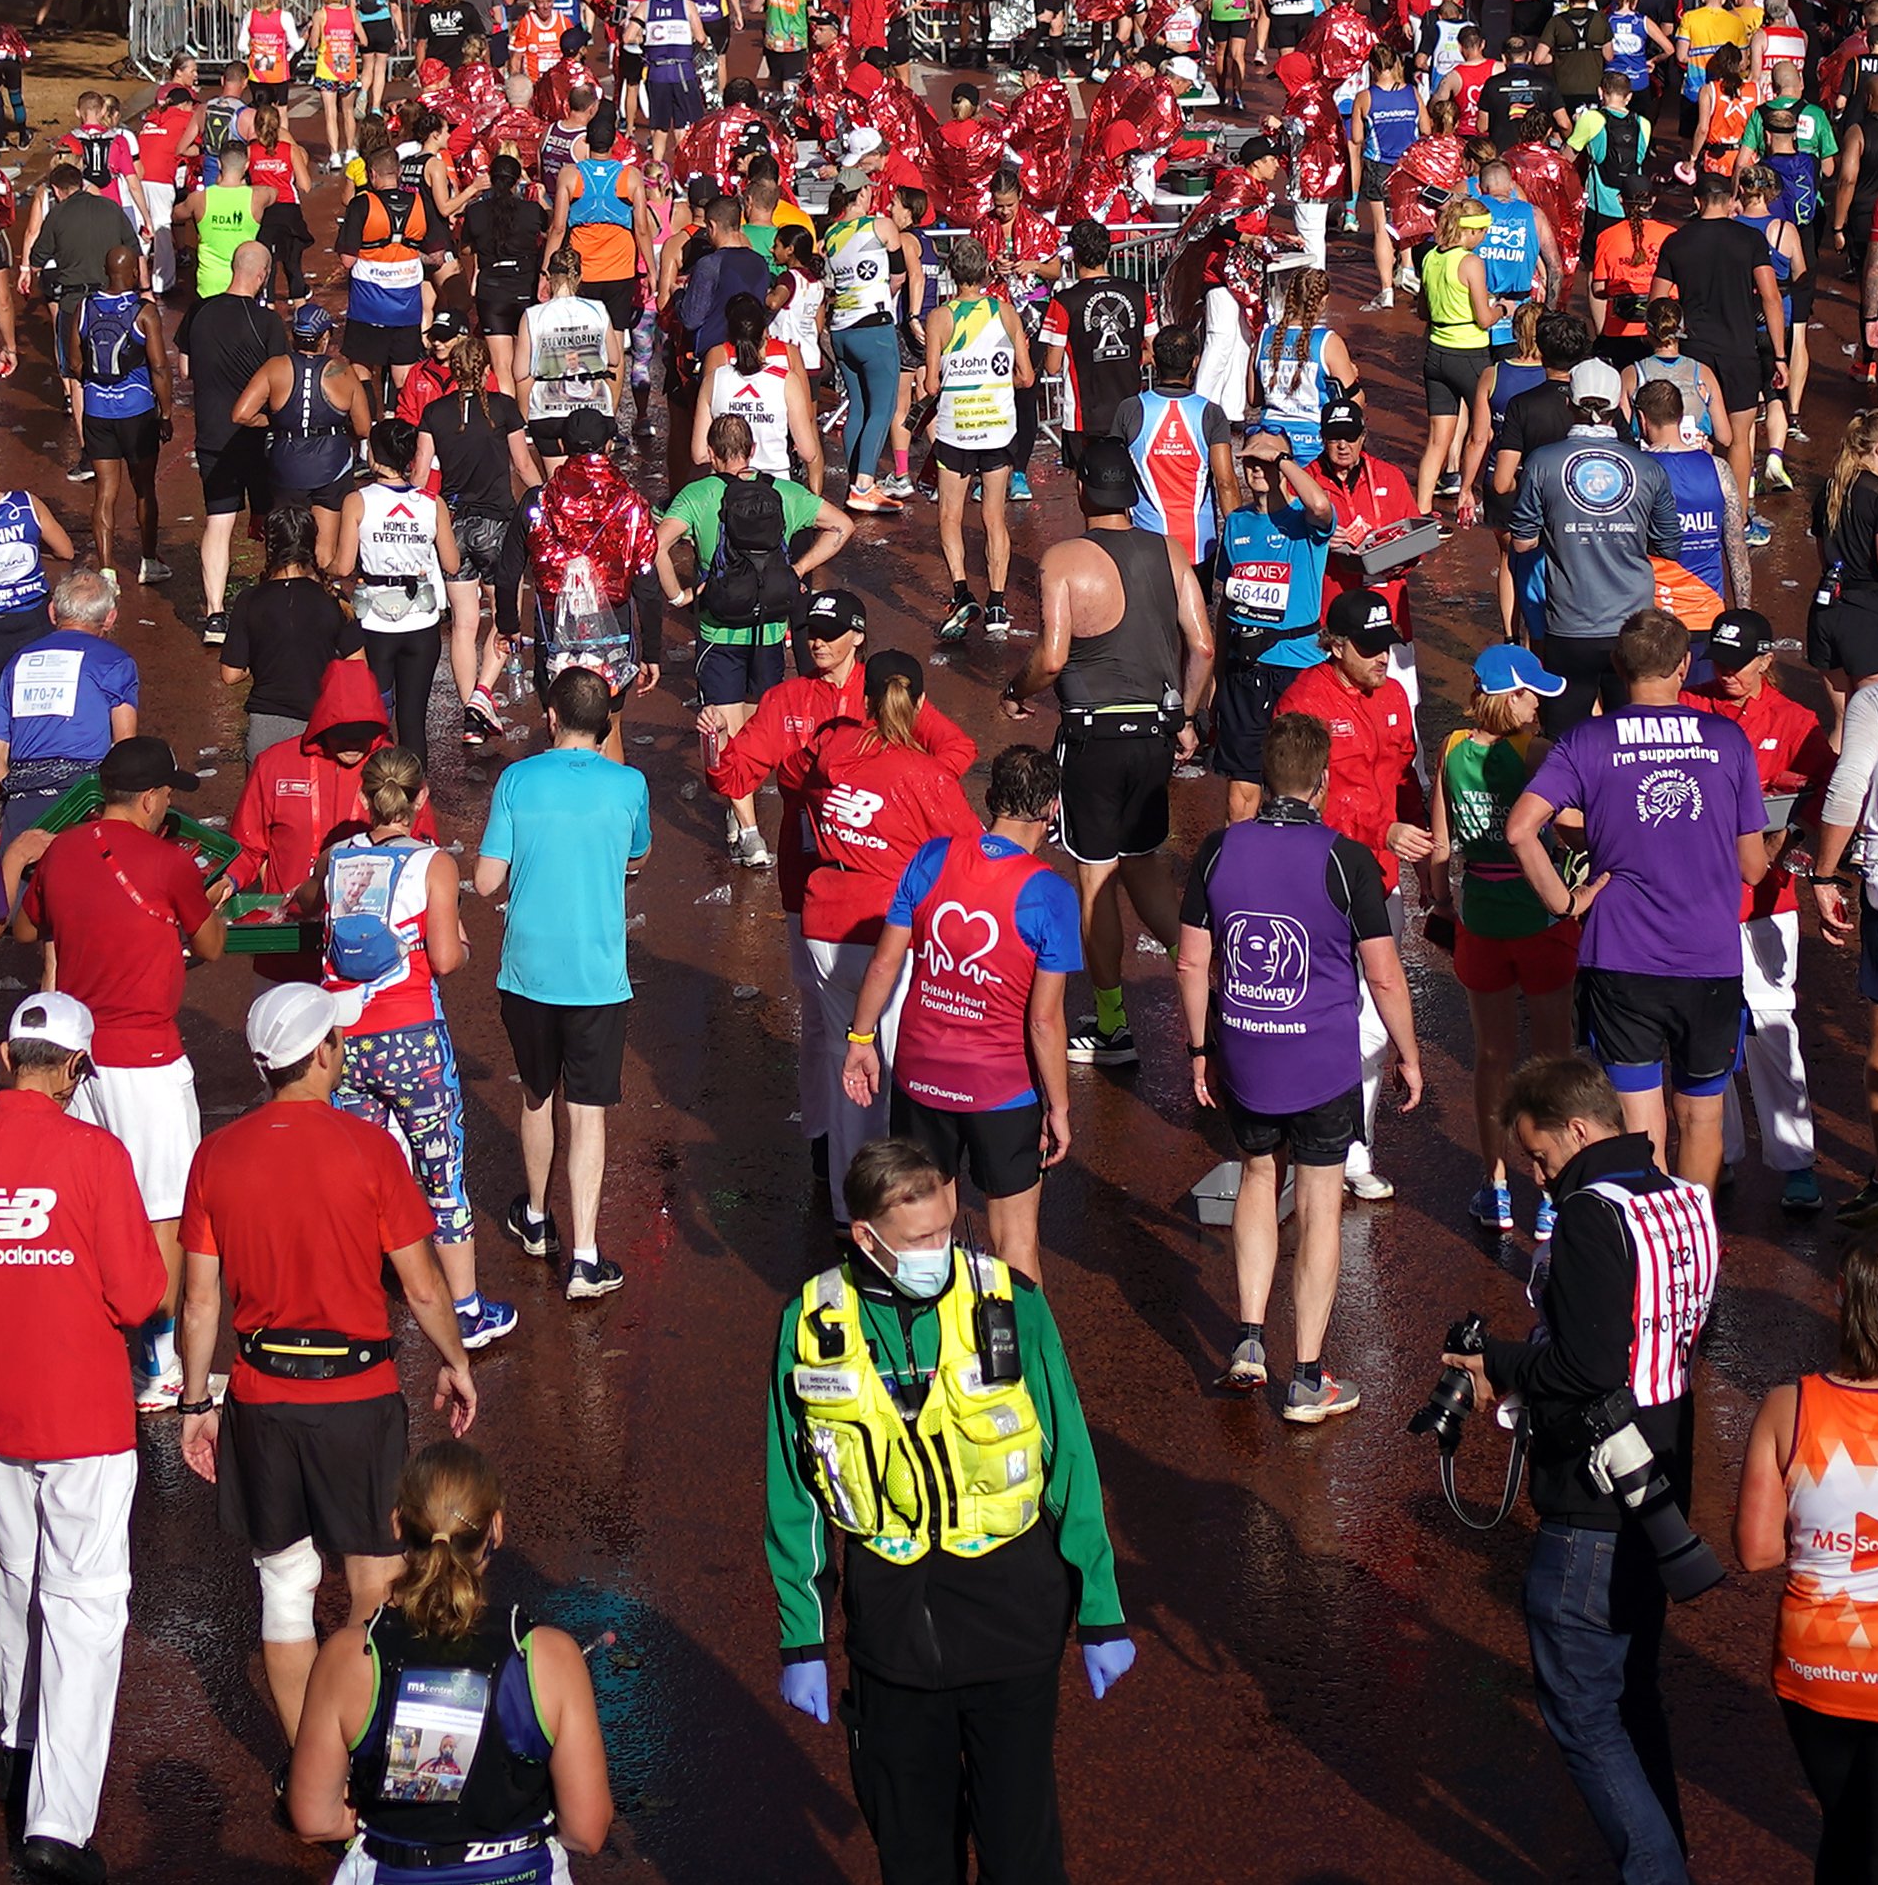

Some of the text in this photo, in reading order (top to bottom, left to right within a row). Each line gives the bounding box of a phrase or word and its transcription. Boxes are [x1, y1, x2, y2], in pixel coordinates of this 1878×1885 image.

[1478, 246, 1526, 263] SHAUN
[959, 356, 988, 368] John
[728, 401, 765, 412] HOME IS
[383, 522, 420, 533] HOME IS
[372, 532, 428, 545] EVERYTHING
[1232, 583, 1280, 604] 56440
[23, 687, 64, 702] M70-74
[1616, 716, 1704, 745] MARK
[1613, 746, 1720, 766] I'm supporting
[1635, 768, 1705, 823] Saint Michael's Hospice
[920, 980, 988, 1011] British Heart
[1227, 979, 1296, 1005] Headway
[920, 997, 984, 1021] Foundation
[1243, 1017, 1308, 1034] Northants
[810, 1376, 840, 1384] MEDICAL
[1810, 1530, 1853, 1553] MS
[1787, 1656, 1860, 1686] Together
